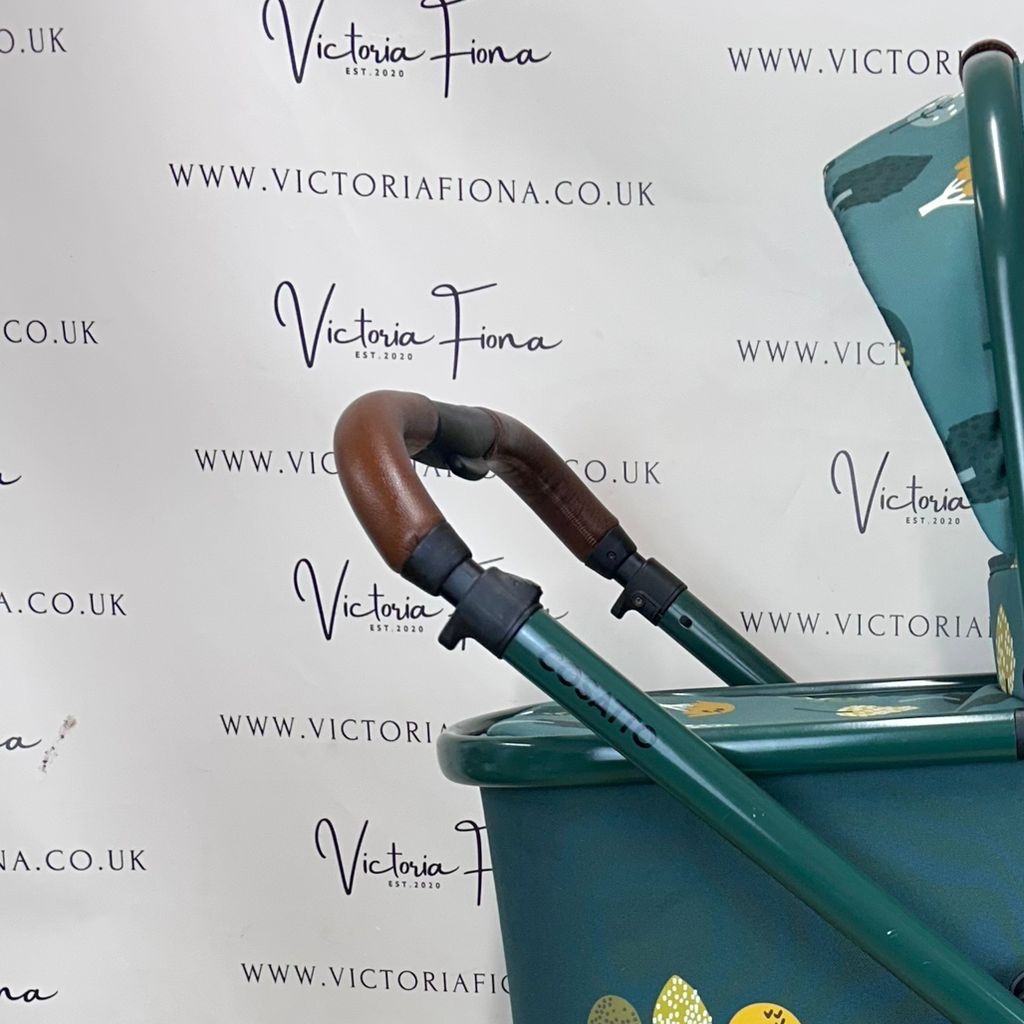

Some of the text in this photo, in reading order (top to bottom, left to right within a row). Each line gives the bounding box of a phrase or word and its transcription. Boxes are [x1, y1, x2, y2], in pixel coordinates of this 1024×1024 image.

[262, 0, 552, 98] Victoria Fiona
[345, 67, 405, 78] EST.2020
[168, 163, 655, 206] WWW.VICTORIAFIONA.CO.UK
[274, 281, 563, 380] Victoria Fiona
[355, 350, 414, 361] EST.2020
[831, 450, 971, 534] Victoria
[906, 516, 961, 526] EST.2020
[293, 558, 444, 640] Victoria
[369, 623, 424, 633] EST.2020
[315, 818, 460, 896] Victoria
[387, 880, 441, 890] EST.2020
